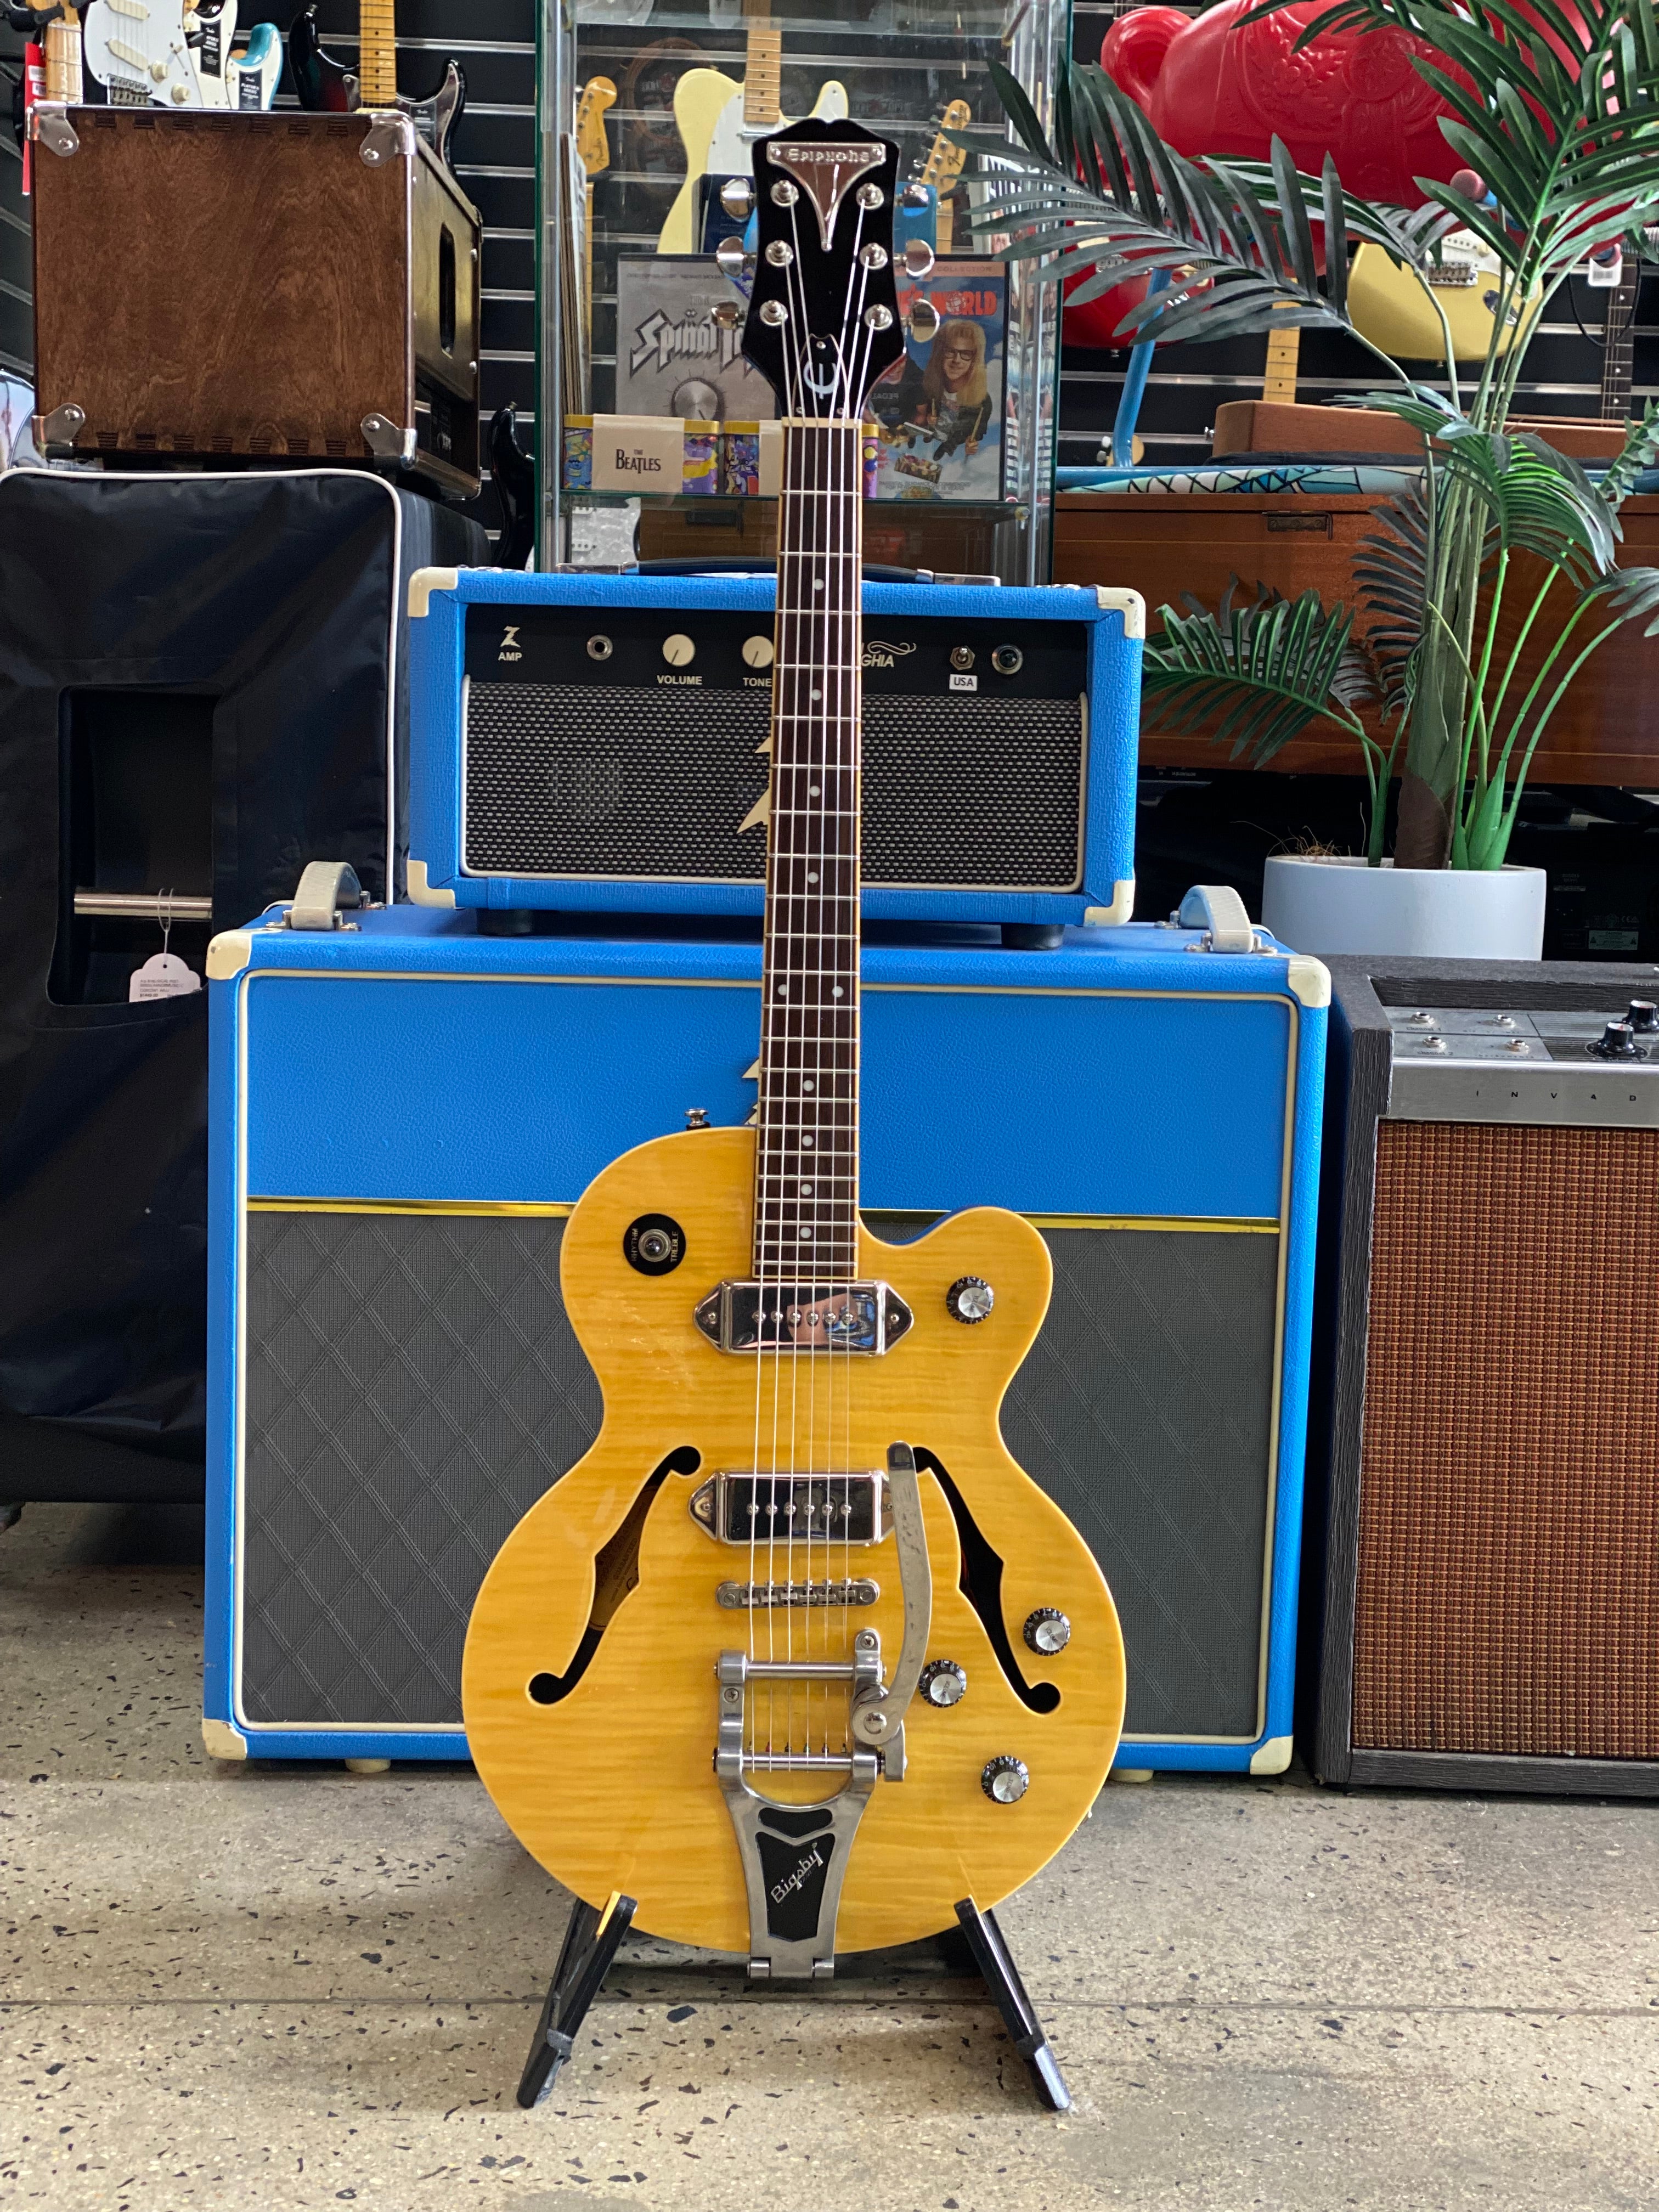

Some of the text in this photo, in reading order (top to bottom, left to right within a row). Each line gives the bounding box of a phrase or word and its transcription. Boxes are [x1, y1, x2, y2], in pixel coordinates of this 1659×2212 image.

[930, 290, 997, 316] WORLD
[616, 449, 662, 474] BEATLES
[498, 651, 523, 662] AMP
[861, 653, 895, 668] GHIA
[656, 675, 703, 685] VOLUME
[742, 677, 772, 687] TONE
[953, 676, 974, 687] USA
[670, 1231, 679, 1262] TREBLE
[770, 1842, 823, 1904] Bigsby
